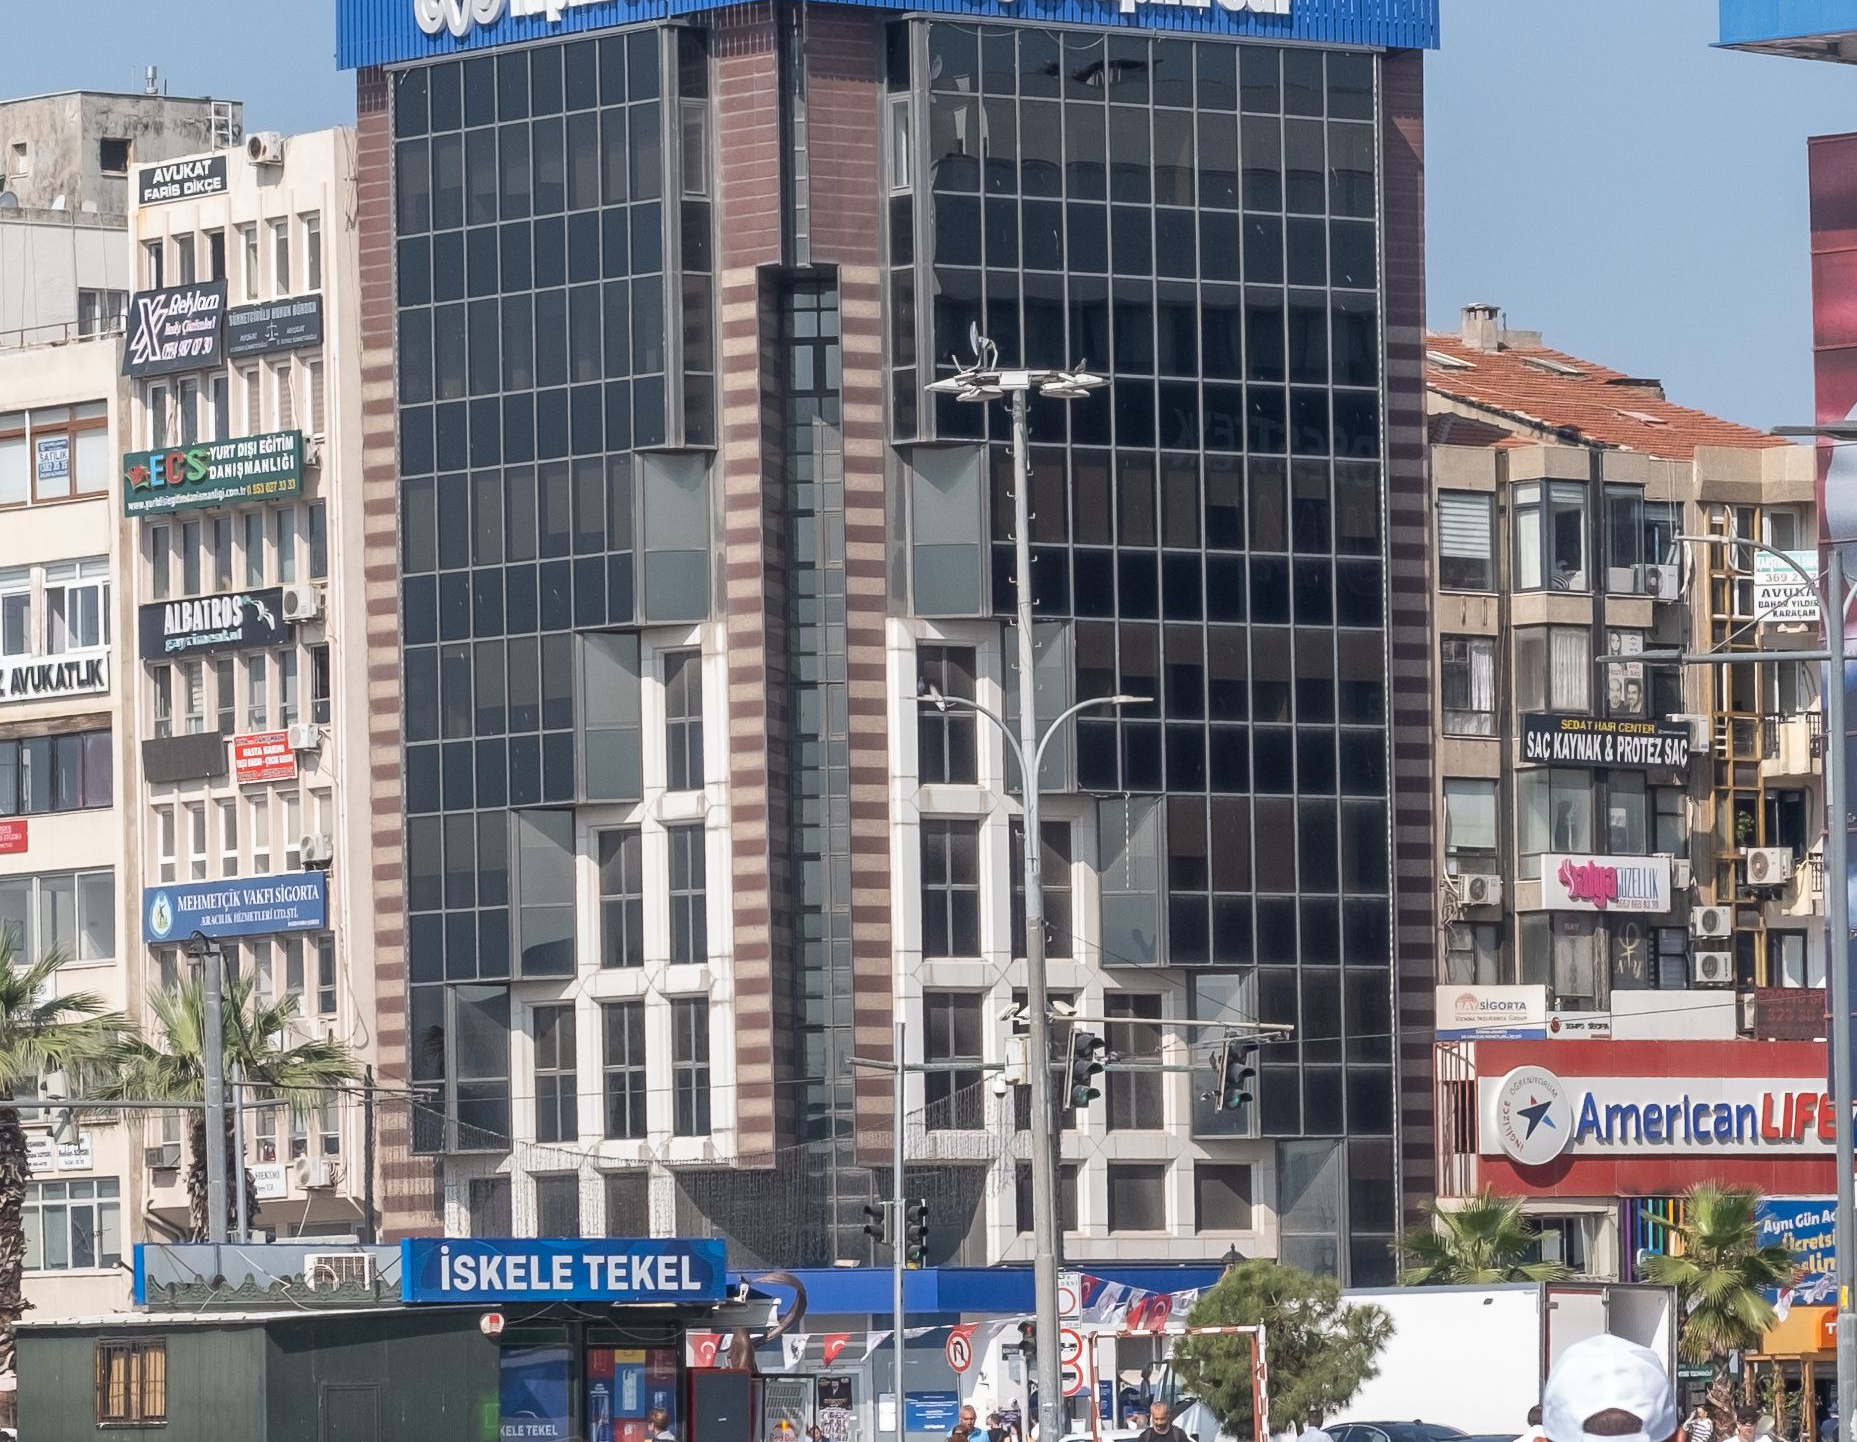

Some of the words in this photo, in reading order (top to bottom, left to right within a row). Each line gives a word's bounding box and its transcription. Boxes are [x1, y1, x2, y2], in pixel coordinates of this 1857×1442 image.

[152, 159, 212, 185] AVUKAT
[183, 176, 222, 194] DİKÇE
[259, 434, 294, 454] EĞİTİM
[209, 455, 294, 480] DANIŞMANLIĞI
[164, 595, 244, 636] ALBATROS
[10, 658, 105, 695] AVUKATLIK
[1561, 719, 1593, 731] SEDAT
[1618, 723, 1655, 734] CENTER
[1527, 731, 1551, 761] SAÇ
[1553, 732, 1602, 762] KAYNAK
[1604, 734, 1613, 762] &
[1617, 736, 1662, 765] PROTEZ
[1664, 738, 1688, 768] SAÇ
[243, 888, 275, 906] VAKFI
[275, 883, 320, 903] SİGORTA
[1479, 998, 1527, 1011] SİGORTA
[1795, 1212, 1820, 1228] Gün
[440, 1245, 574, 1291] İSKELE
[582, 1255, 702, 1291] TEKEL
[527, 1425, 558, 1437] TEKEL
